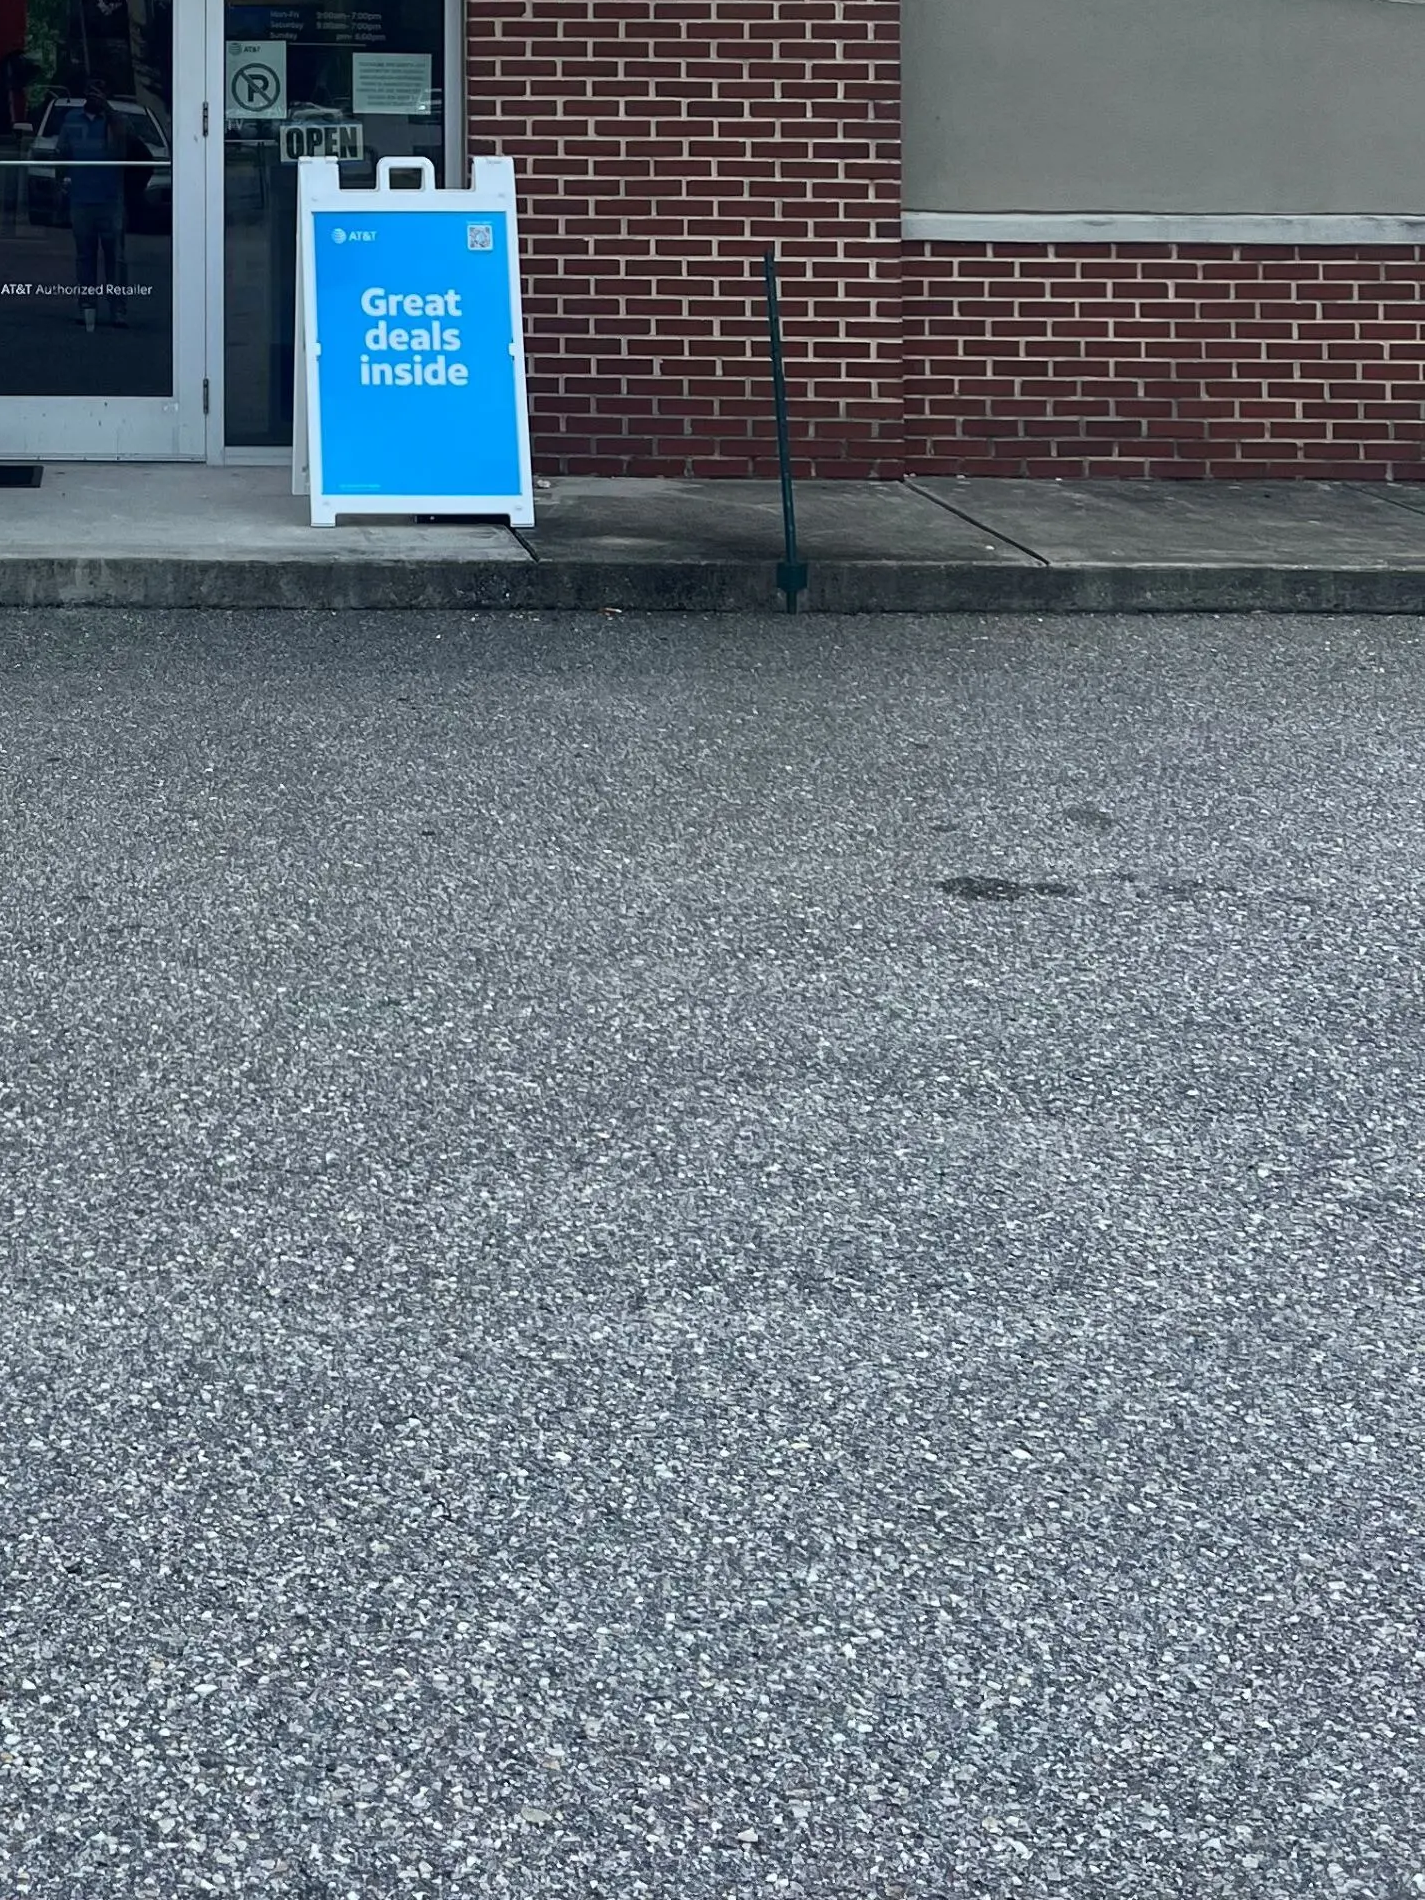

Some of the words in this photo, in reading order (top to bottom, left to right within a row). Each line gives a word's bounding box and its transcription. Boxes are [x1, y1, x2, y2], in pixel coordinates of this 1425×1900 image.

[270, 21, 304, 30] Saturday
[269, 32, 297, 41] Sunday
[286, 127, 358, 159] OPEN
[349, 231, 377, 241] AT&T
[1, 283, 32, 295] AT&T
[35, 283, 104, 295] Authorized
[106, 283, 153, 295] Retailer
[361, 287, 462, 316] Great
[365, 320, 462, 351] deals
[360, 354, 469, 386] inside
